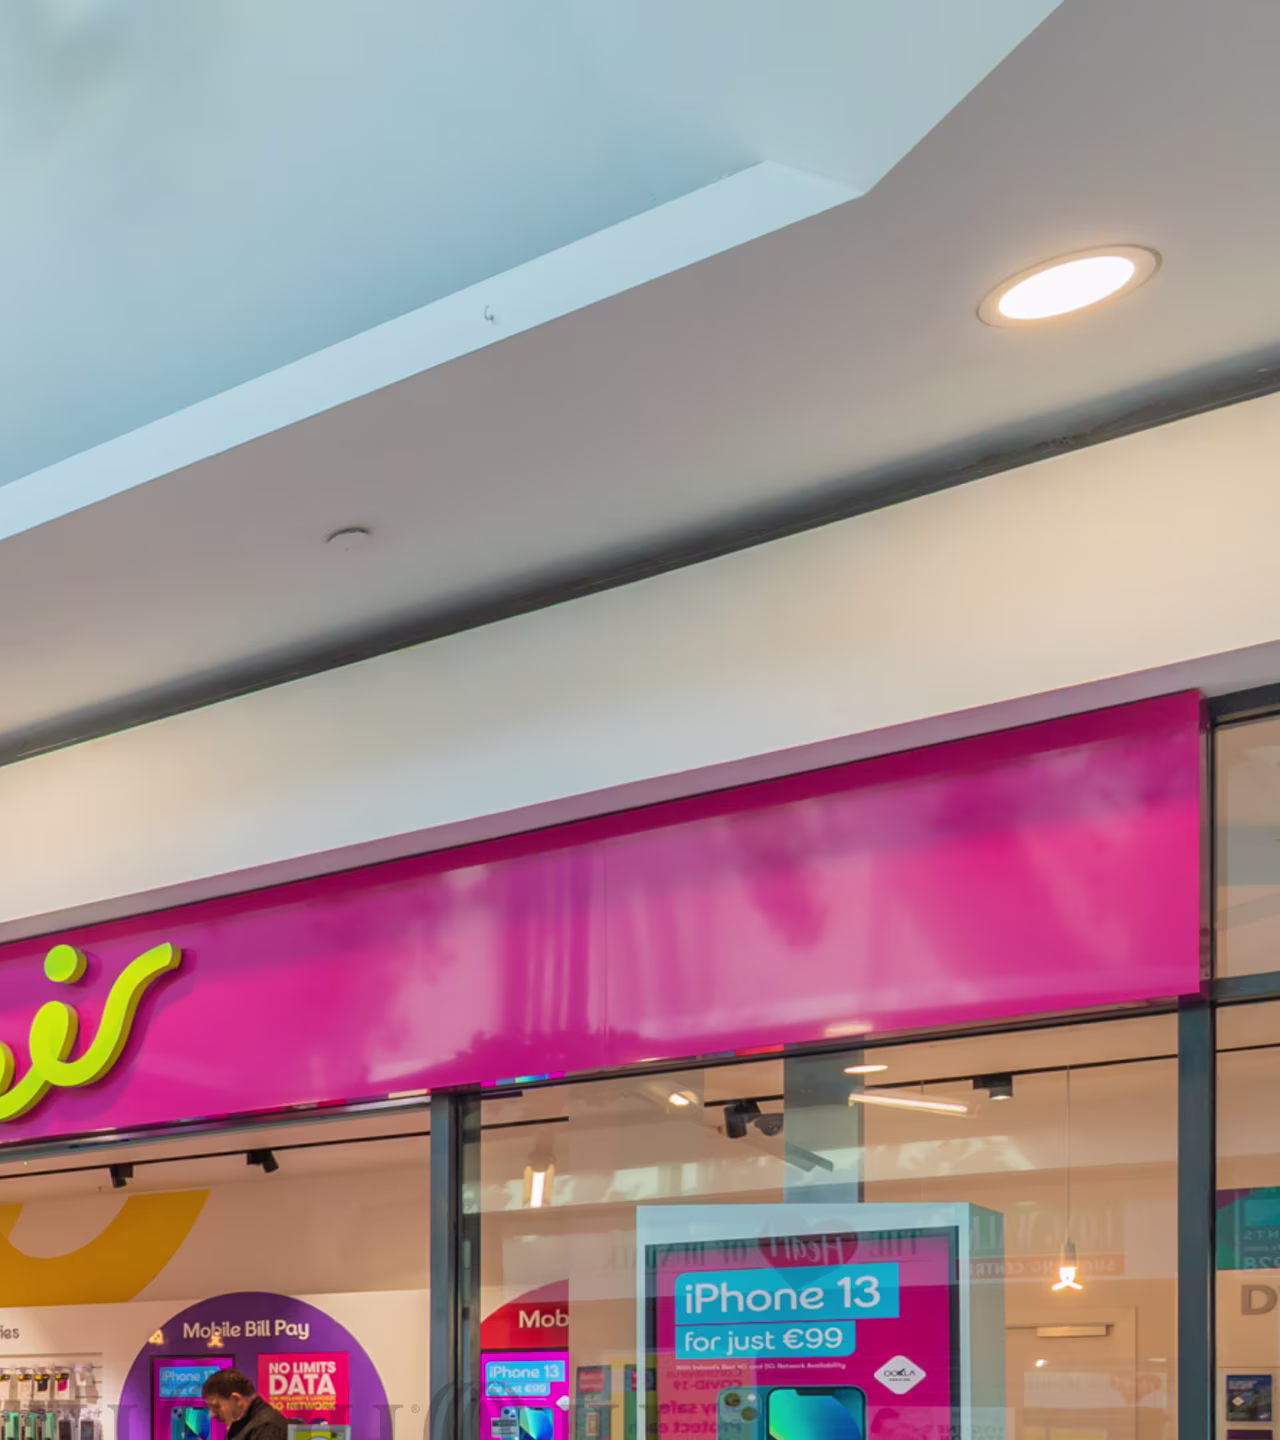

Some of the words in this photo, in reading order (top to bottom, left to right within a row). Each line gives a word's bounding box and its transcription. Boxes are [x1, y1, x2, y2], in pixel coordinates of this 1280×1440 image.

[685, 1281, 824, 1314] iPhone
[837, 1275, 881, 1309] 13
[518, 1309, 569, 1328] Mob
[183, 1321, 241, 1340] Mobile
[245, 1320, 271, 1338] Bill
[275, 1319, 310, 1341] Pay
[684, 1332, 721, 1352] for
[725, 1330, 775, 1356] just
[782, 1327, 843, 1350] €99
[269, 1362, 290, 1374] NO
[293, 1361, 336, 1374] LIMITS
[489, 1365, 540, 1379] iPhone
[543, 1364, 560, 1379] 13
[269, 1374, 336, 1395] DATA
[286, 1402, 336, 1411] NETWORK
